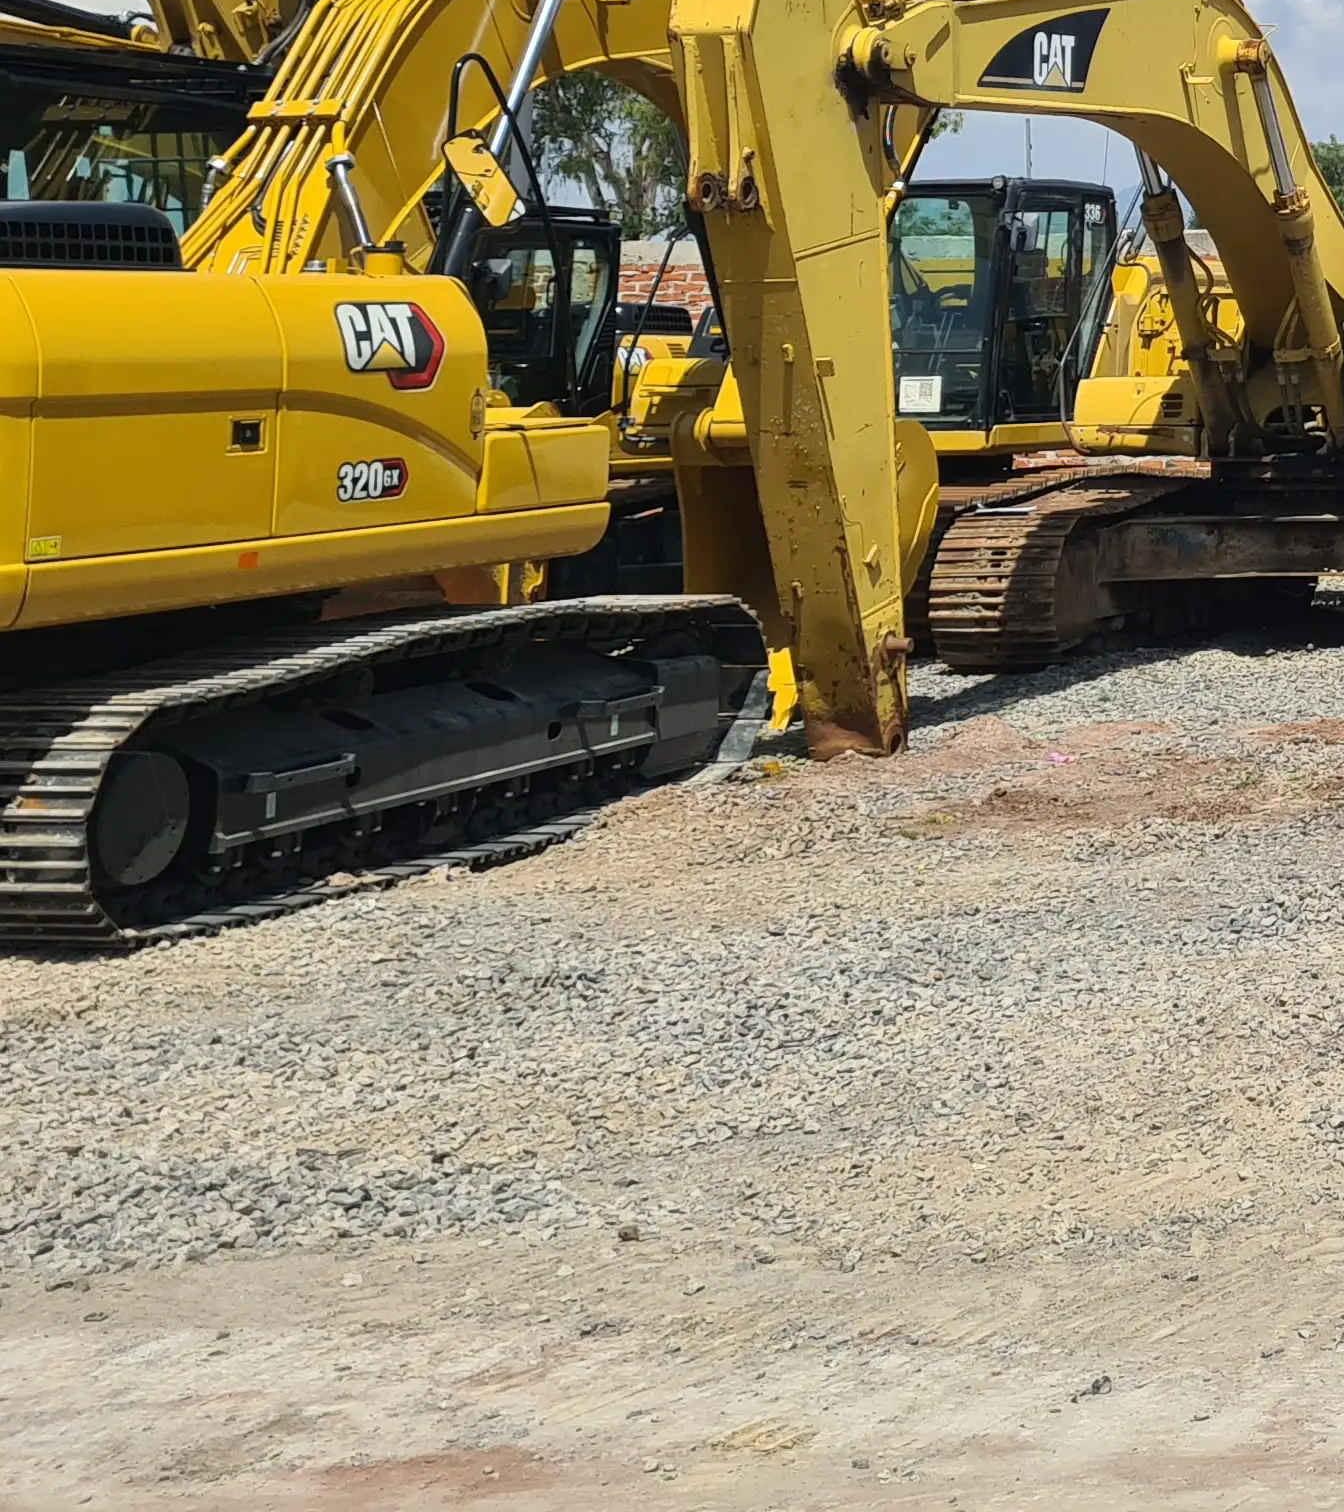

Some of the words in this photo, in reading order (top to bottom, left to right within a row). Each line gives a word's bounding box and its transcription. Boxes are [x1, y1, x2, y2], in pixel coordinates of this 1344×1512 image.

[1034, 31, 1075, 87] CAT
[1084, 203, 1101, 221] 336
[336, 303, 416, 370] CAT
[338, 461, 384, 501] 320
